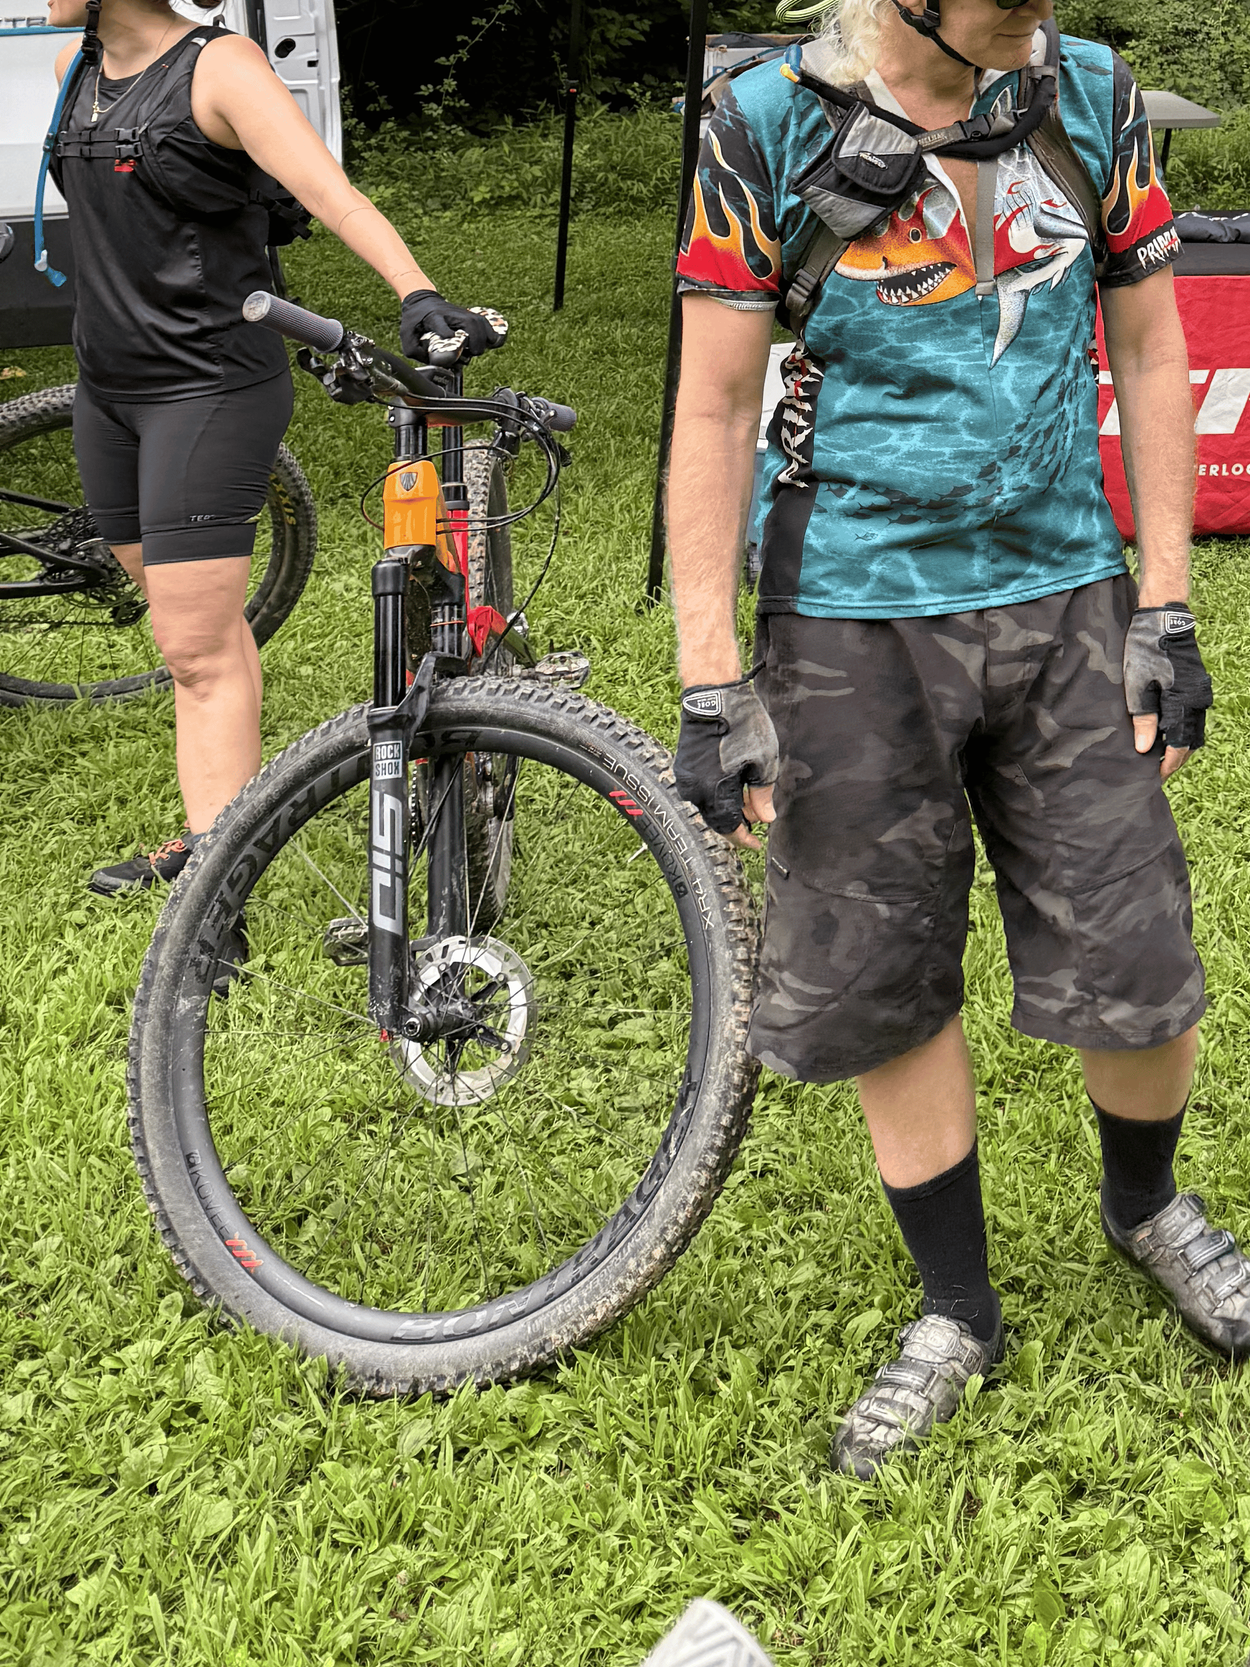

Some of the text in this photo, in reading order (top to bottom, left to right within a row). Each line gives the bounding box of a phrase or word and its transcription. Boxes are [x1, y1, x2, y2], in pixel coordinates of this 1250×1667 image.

[1136, 226, 1180, 270] PRIMA
[375, 744, 400, 761] ROCK
[375, 761, 400, 777] SHOX
[372, 789, 403, 936] SID
[602, 752, 715, 930] XR4 TEAM ISSUE
